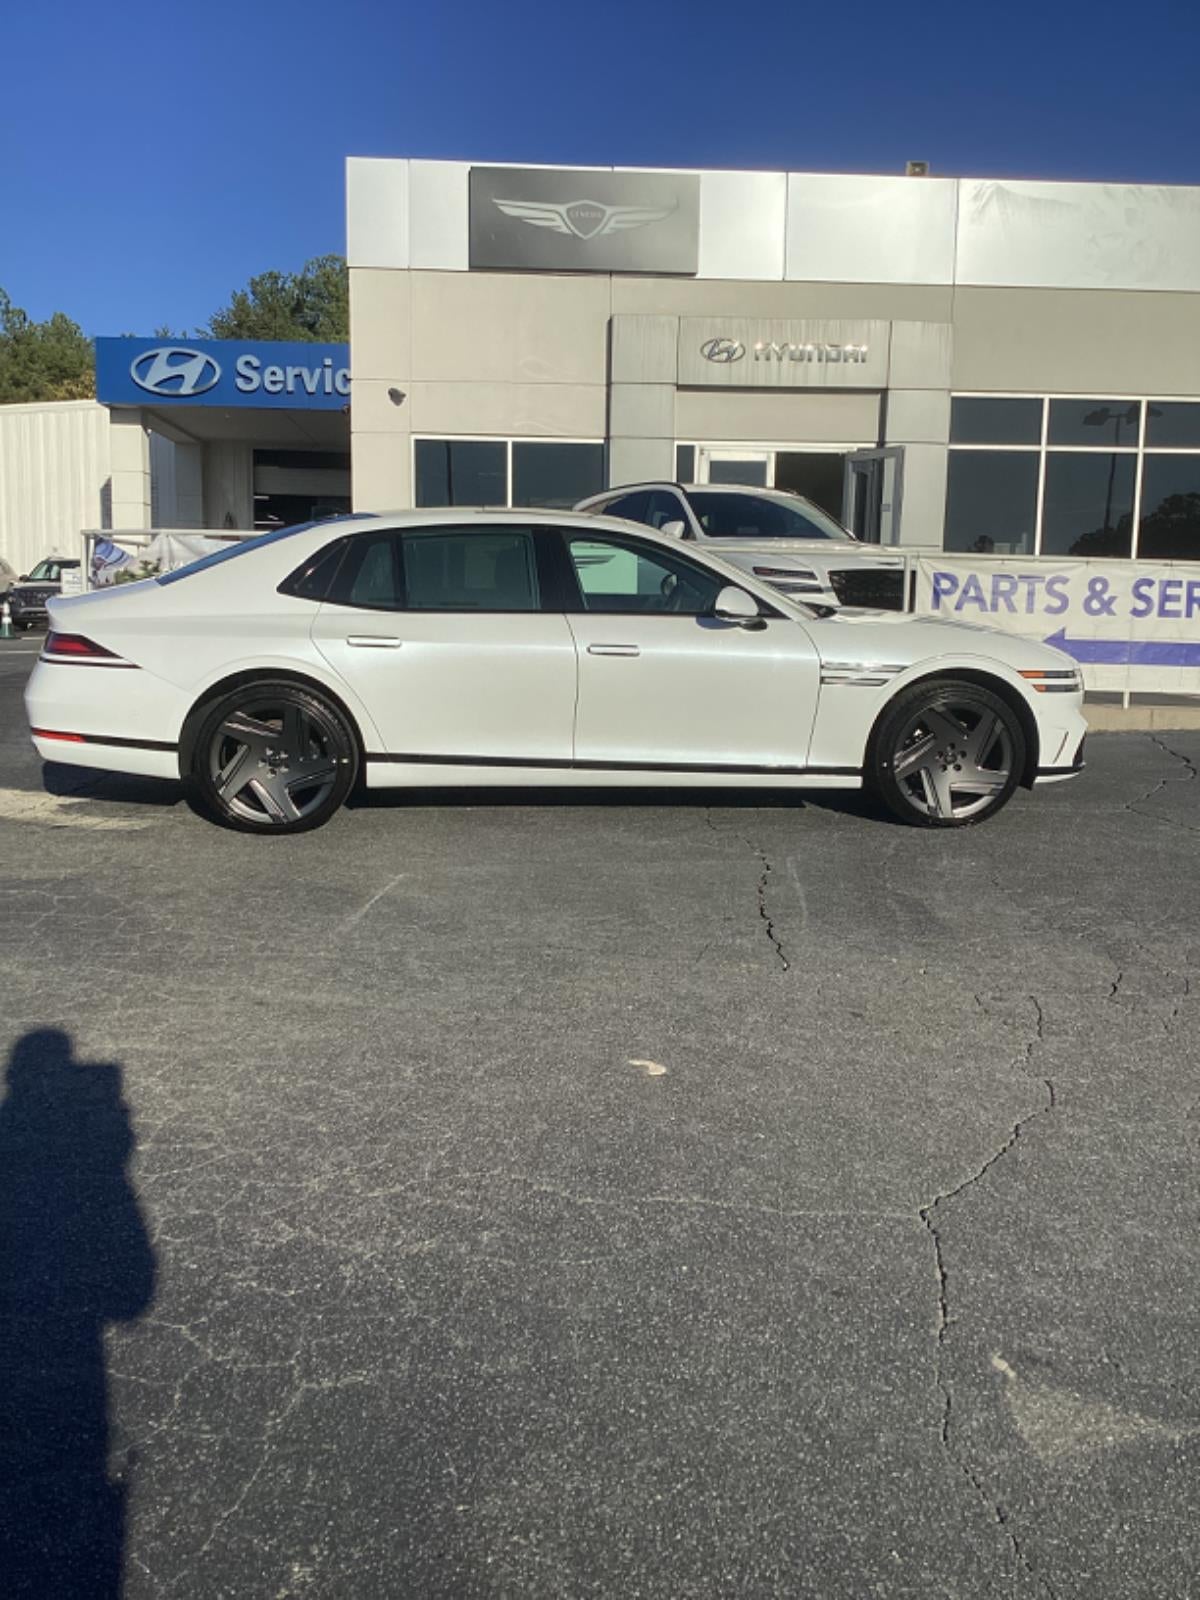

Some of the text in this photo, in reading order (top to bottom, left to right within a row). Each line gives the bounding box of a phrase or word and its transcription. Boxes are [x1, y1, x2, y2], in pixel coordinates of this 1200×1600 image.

[235, 354, 351, 395] Servic
[931, 572, 1070, 615] PARTS
[1083, 576, 1118, 616] &
